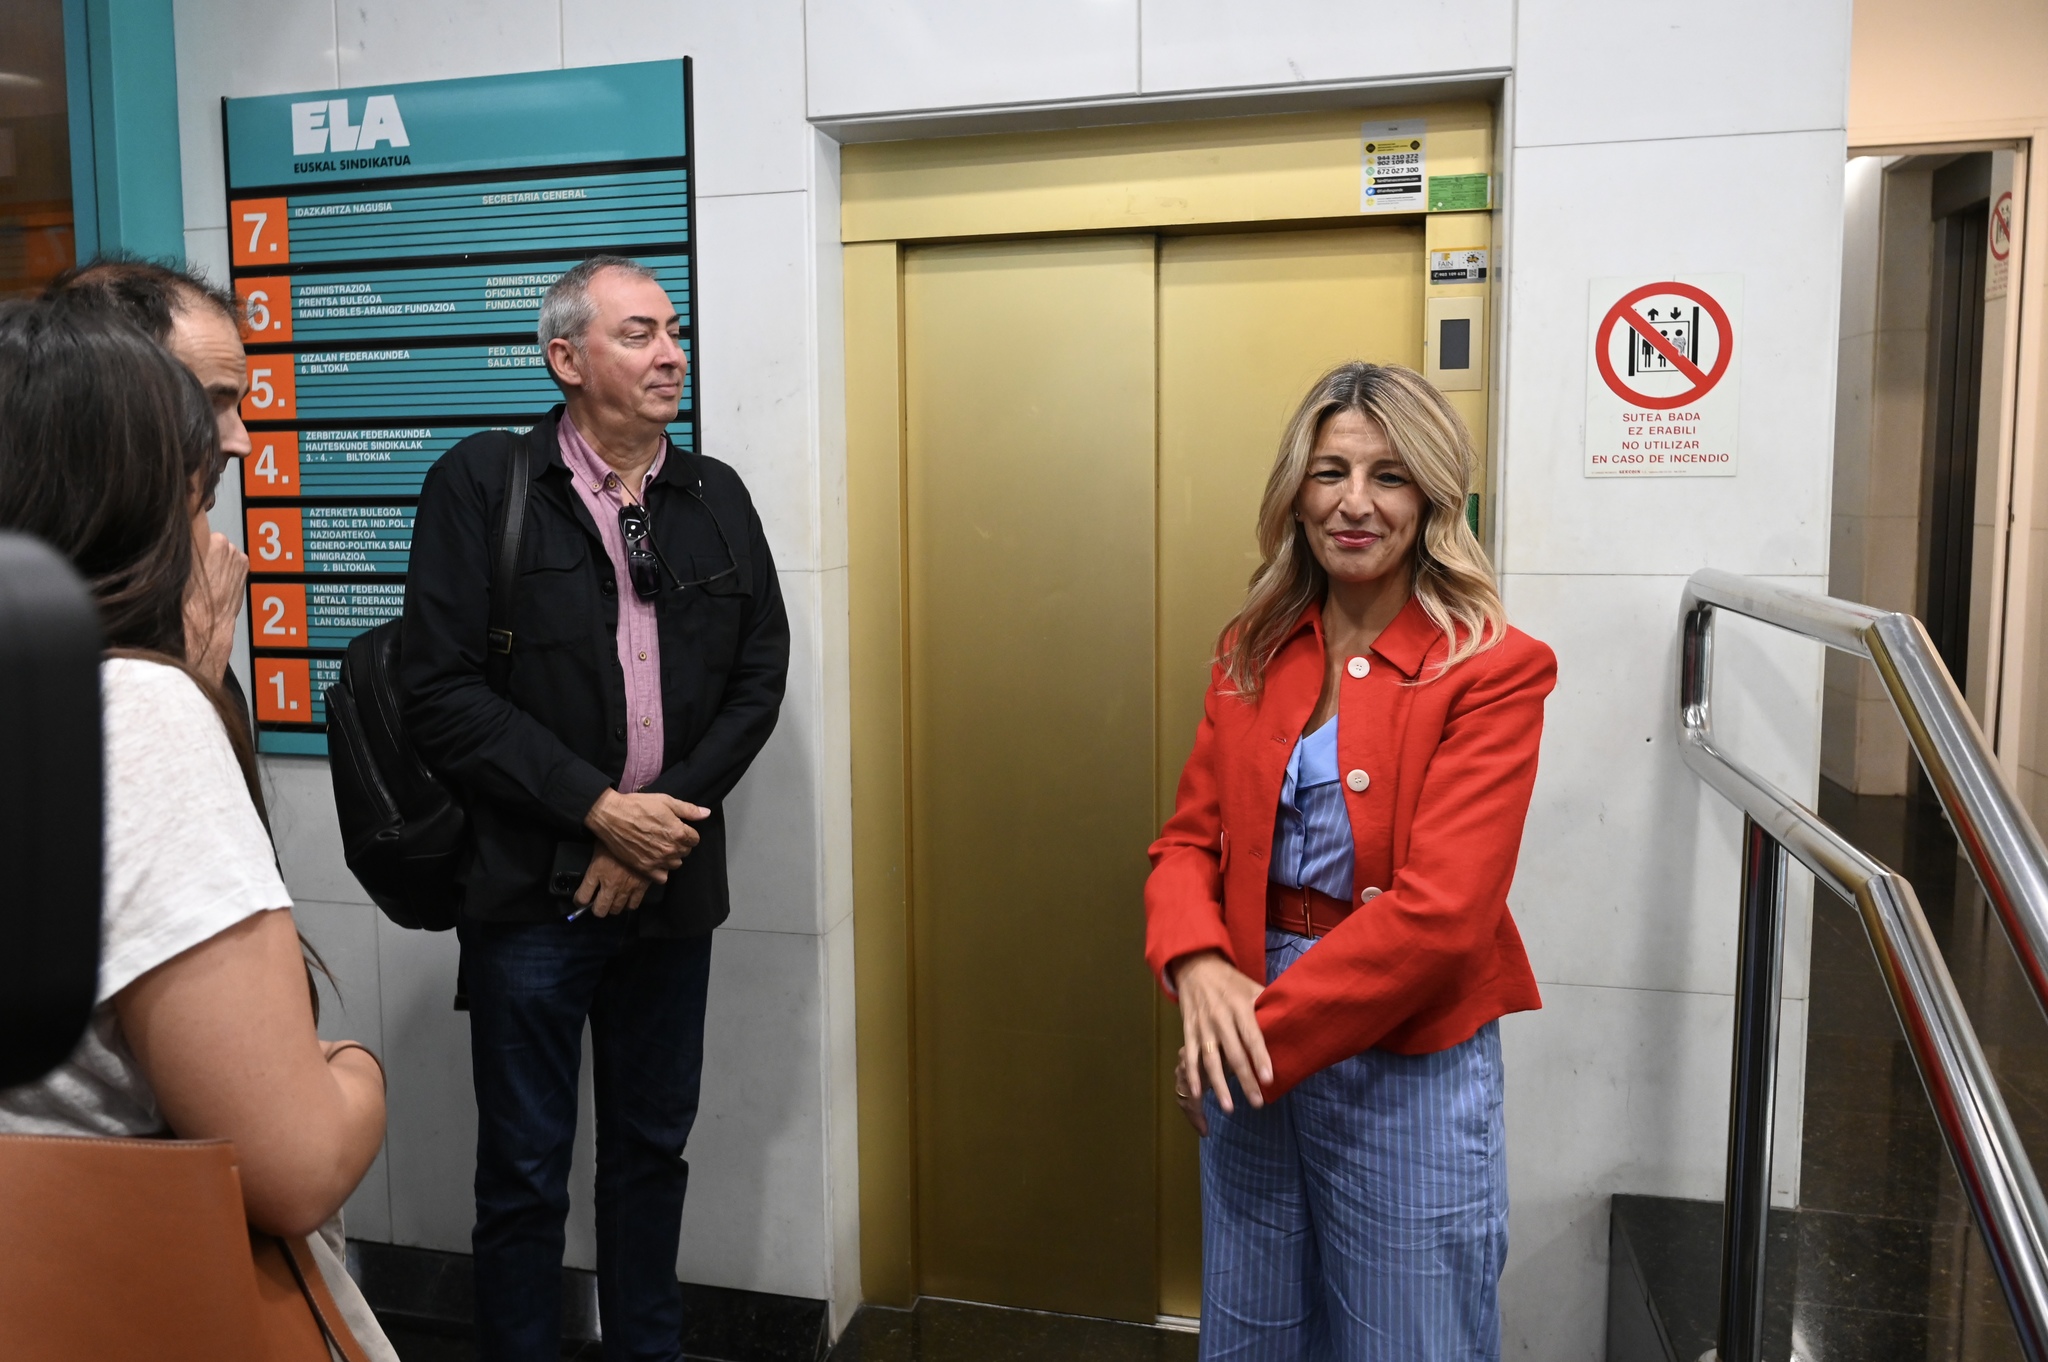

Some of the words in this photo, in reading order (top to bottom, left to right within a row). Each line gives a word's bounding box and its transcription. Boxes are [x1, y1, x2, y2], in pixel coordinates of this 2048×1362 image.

[291, 94, 410, 156] ELA
[294, 161, 336, 174] EUSKAL
[340, 155, 411, 170] SINDIKATUA
[482, 192, 540, 205] SECRETARIA
[542, 189, 588, 201] GENERAL
[295, 204, 352, 217] IDAZKARITZA
[353, 202, 392, 213] NAGUSIA
[243, 213, 278, 252] 7.
[300, 284, 372, 296] ADMINISTRAZIOA
[485, 288, 522, 298] OFICINA
[524, 288, 536, 296] DE
[299, 297, 338, 307] PRENTSA
[340, 295, 382, 306] BULEGOA
[486, 299, 539, 310] FUNDACION
[247, 290, 282, 332] 6.
[300, 308, 324, 318] MANU
[327, 304, 402, 318] ROBLES-ARANGIZ
[405, 303, 456, 314] FUNDAZIOA
[301, 353, 338, 363] GIZALAN
[340, 350, 410, 362] FEDERAKUNDEA
[488, 347, 509, 356] FED.
[488, 358, 512, 368] SALA
[514, 357, 526, 366] DE
[302, 365, 309, 374] 6.
[311, 364, 348, 374] BILTOKIA
[250, 368, 284, 408] 5.
[1622, 413, 1662, 422] SUTEA
[1668, 412, 1701, 421] BADA
[306, 431, 358, 440] ZERBITZUAK
[361, 429, 432, 440] FEDERAKUNDEA
[1628, 426, 1643, 435] EZ
[1649, 426, 1696, 434] ERABILI
[306, 442, 368, 452] HAUTESKUNDE
[371, 440, 422, 450] SINDIKALAK
[1622, 441, 1640, 450] NO
[1644, 440, 1700, 450] UTILIZAR
[346, 452, 390, 462] BILTOKIAK
[1592, 455, 1608, 464] EN
[1612, 454, 1644, 464] CASO
[1650, 454, 1664, 463] DE
[1670, 453, 1729, 463] INCENDIO
[254, 444, 290, 484] 4.
[310, 508, 358, 517] AZTERKETA
[360, 508, 402, 516] BULEGOA
[310, 520, 330, 528] NEG.
[332, 520, 350, 528] KOL
[352, 520, 368, 528] ETA
[310, 530, 376, 539] NAZIOARTEKOA
[258, 521, 293, 560] 3.
[310, 541, 386, 550] GENERO-POLITIKA
[311, 552, 366, 560] INMIGRAZIOA
[324, 563, 330, 572] 2.
[313, 584, 349, 594] HAINBAT
[314, 596, 346, 604] METALA
[262, 596, 297, 635] 2.
[314, 606, 350, 616] LANBIDE
[315, 618, 332, 626] LAN
[316, 660, 342, 670] BILBO
[317, 671, 339, 680] E.T.E.
[269, 671, 298, 710] 1.
